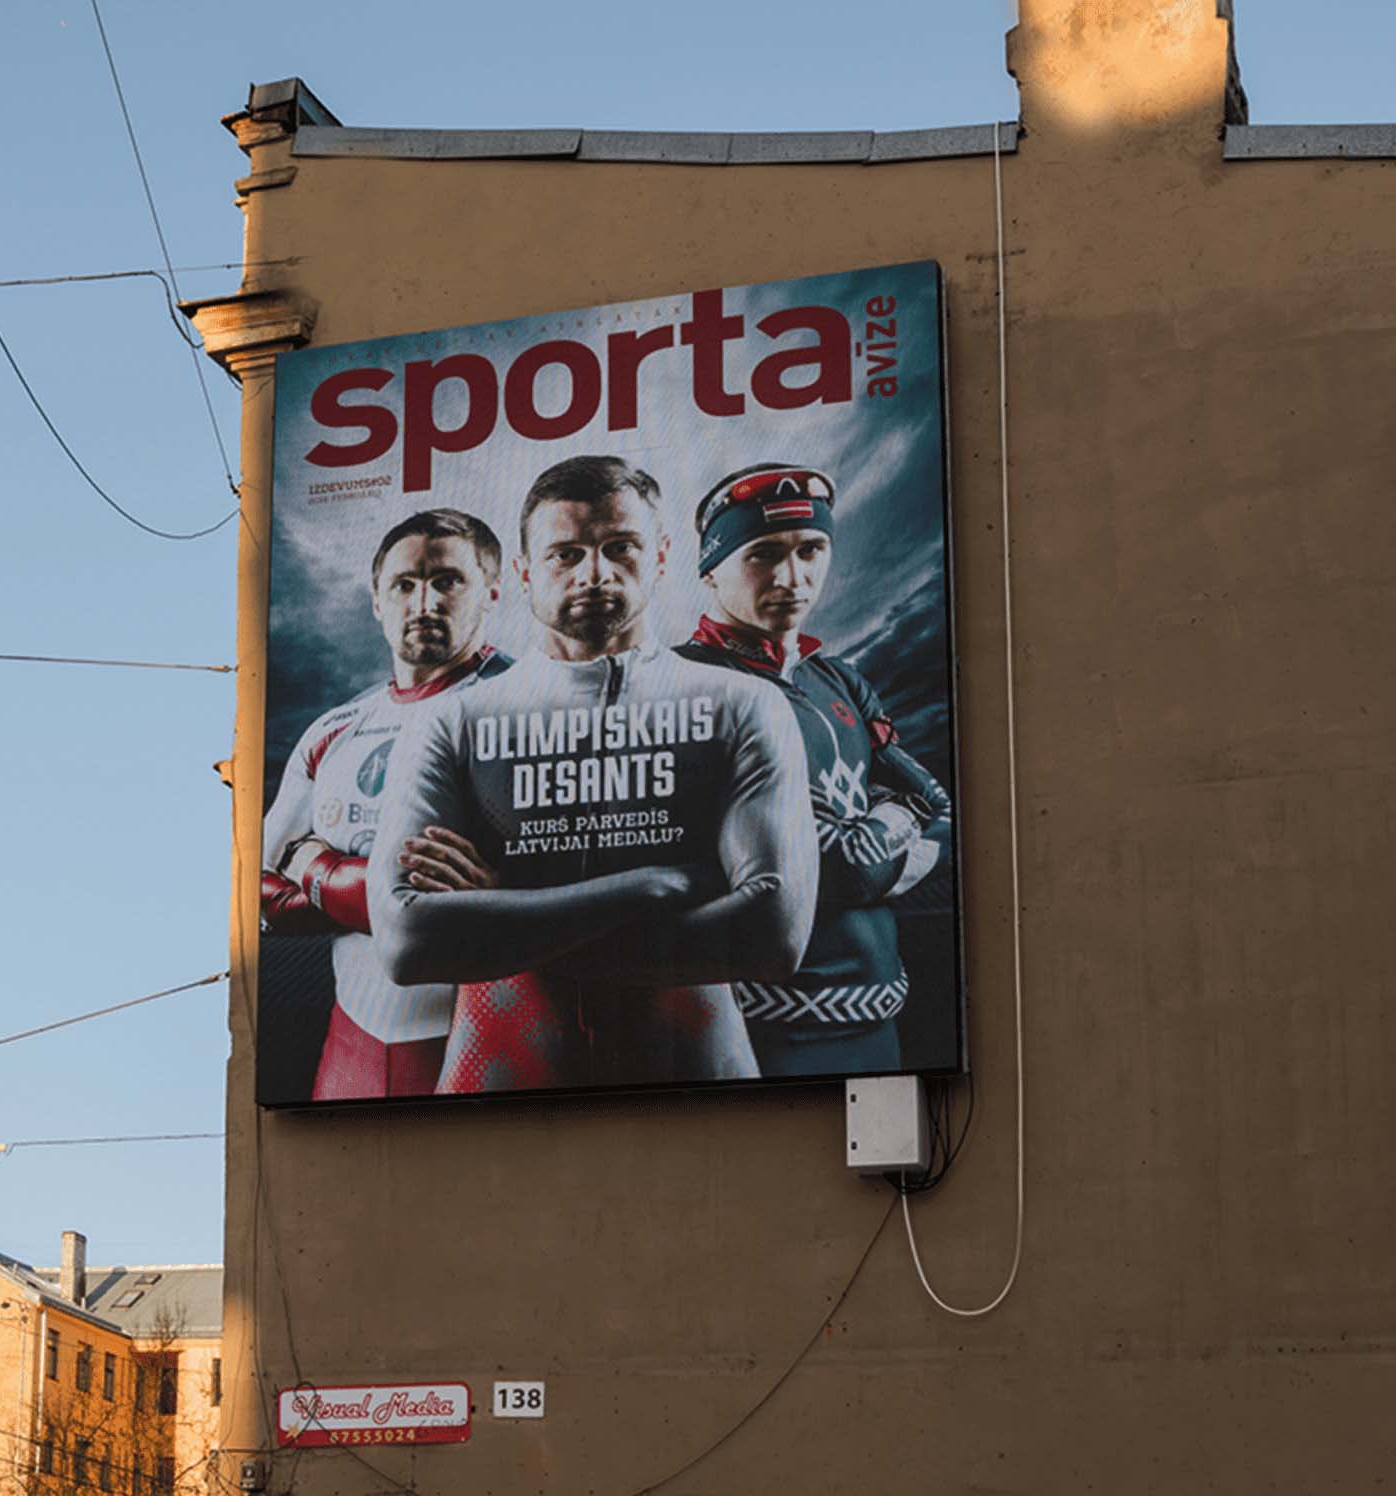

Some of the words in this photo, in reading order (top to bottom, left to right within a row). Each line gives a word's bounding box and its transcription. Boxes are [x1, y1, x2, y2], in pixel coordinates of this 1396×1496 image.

[855, 295, 897, 399] avīze
[304, 288, 853, 493] sporta
[476, 695, 715, 761] OLIMPISKAIS
[513, 751, 676, 809] DESANTS
[520, 816, 570, 836] KURŠ
[575, 806, 670, 832] PĀRVEDĪS
[504, 837, 590, 856] LATVIJAI
[291, 1393, 371, 1421] Visual
[372, 1392, 455, 1424] Media
[497, 1388, 542, 1410] 138
[330, 1429, 416, 1444] 67555024
